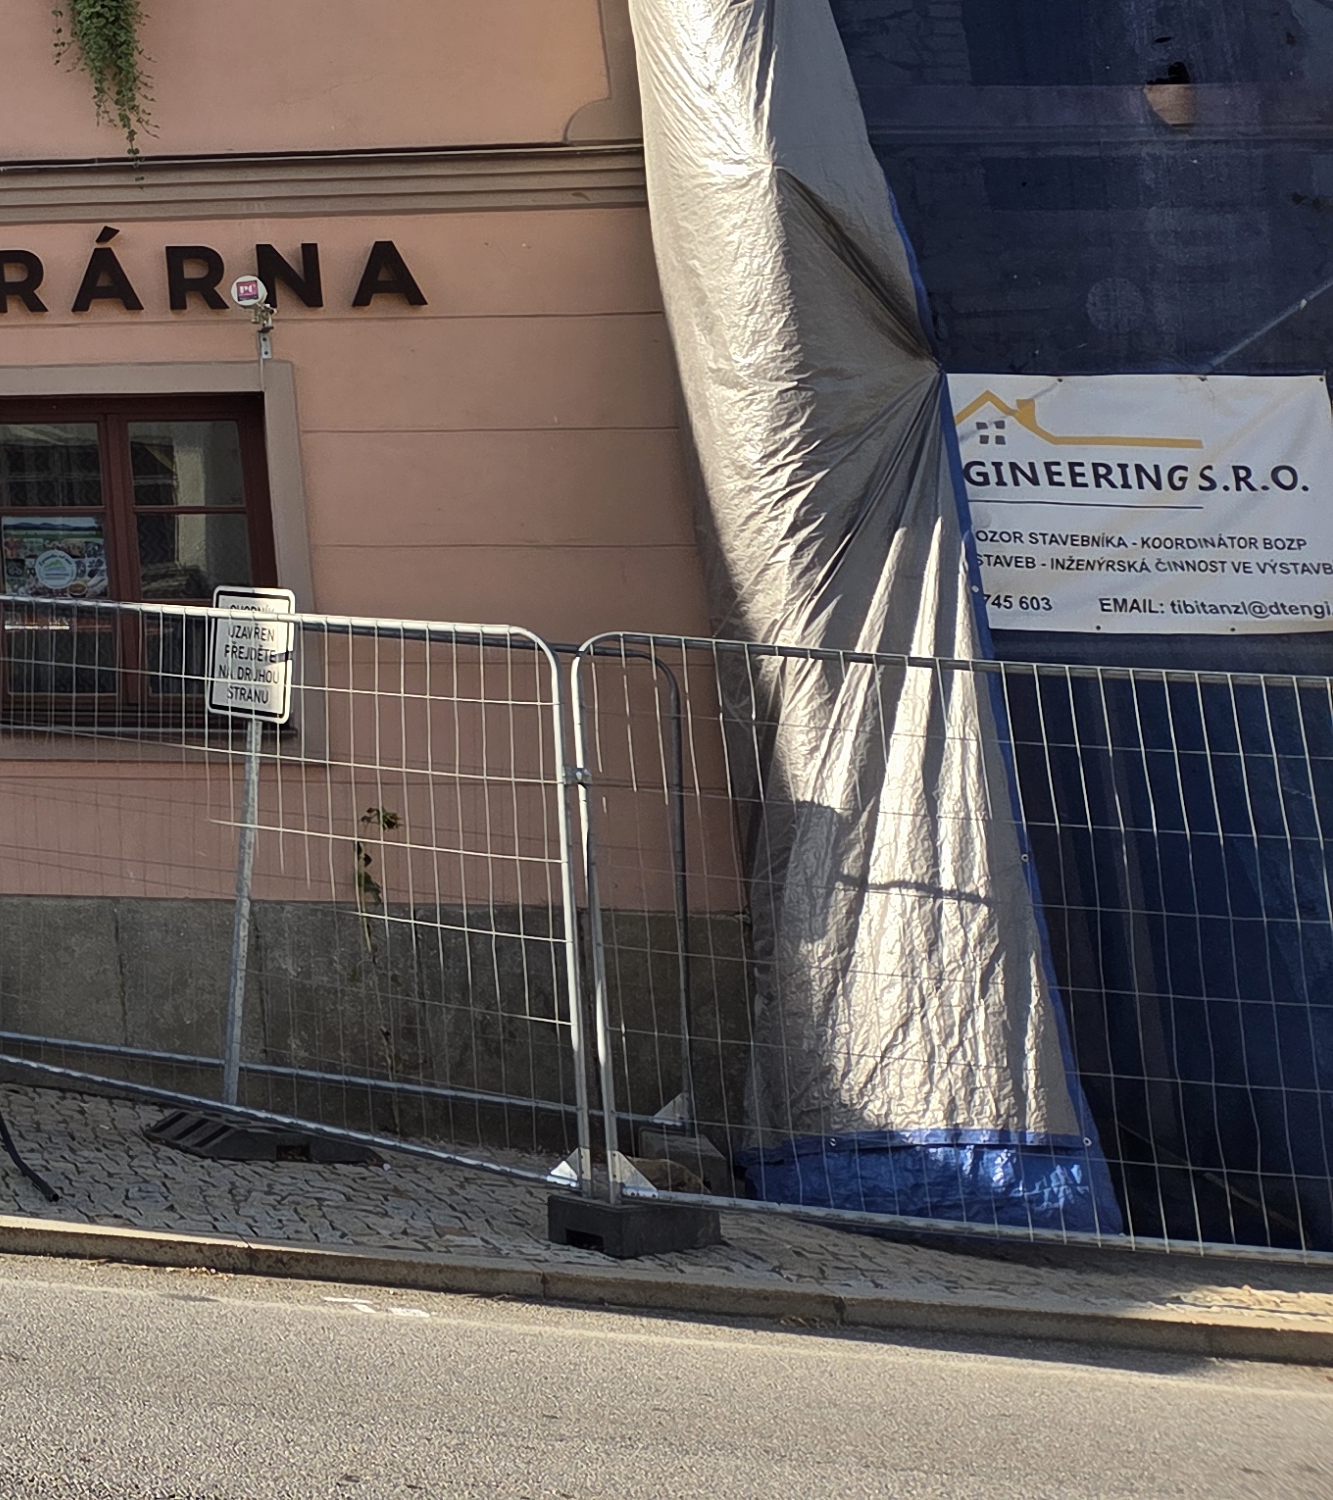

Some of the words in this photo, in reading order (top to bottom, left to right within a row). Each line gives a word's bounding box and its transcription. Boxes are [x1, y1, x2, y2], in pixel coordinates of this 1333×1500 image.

[1198, 464, 1310, 493] S.R.O.
[975, 529, 1024, 544] OZOR
[1028, 531, 1129, 550] STAVEBNÍKA
[1140, 533, 1260, 551] KOORDINÁTOR
[1262, 537, 1308, 551] BOZP
[1050, 555, 1152, 574] INŽENÝRSKÁ
[1154, 557, 1228, 574] ČINNOST
[1230, 561, 1254, 575] VE
[1255, 558, 1333, 576] VÝSTAVB
[1018, 595, 1054, 612] 603
[1098, 597, 1166, 615] EMAIL:
[223, 641, 278, 664] PŘEJDĚTE
[226, 685, 270, 704] STRANU
